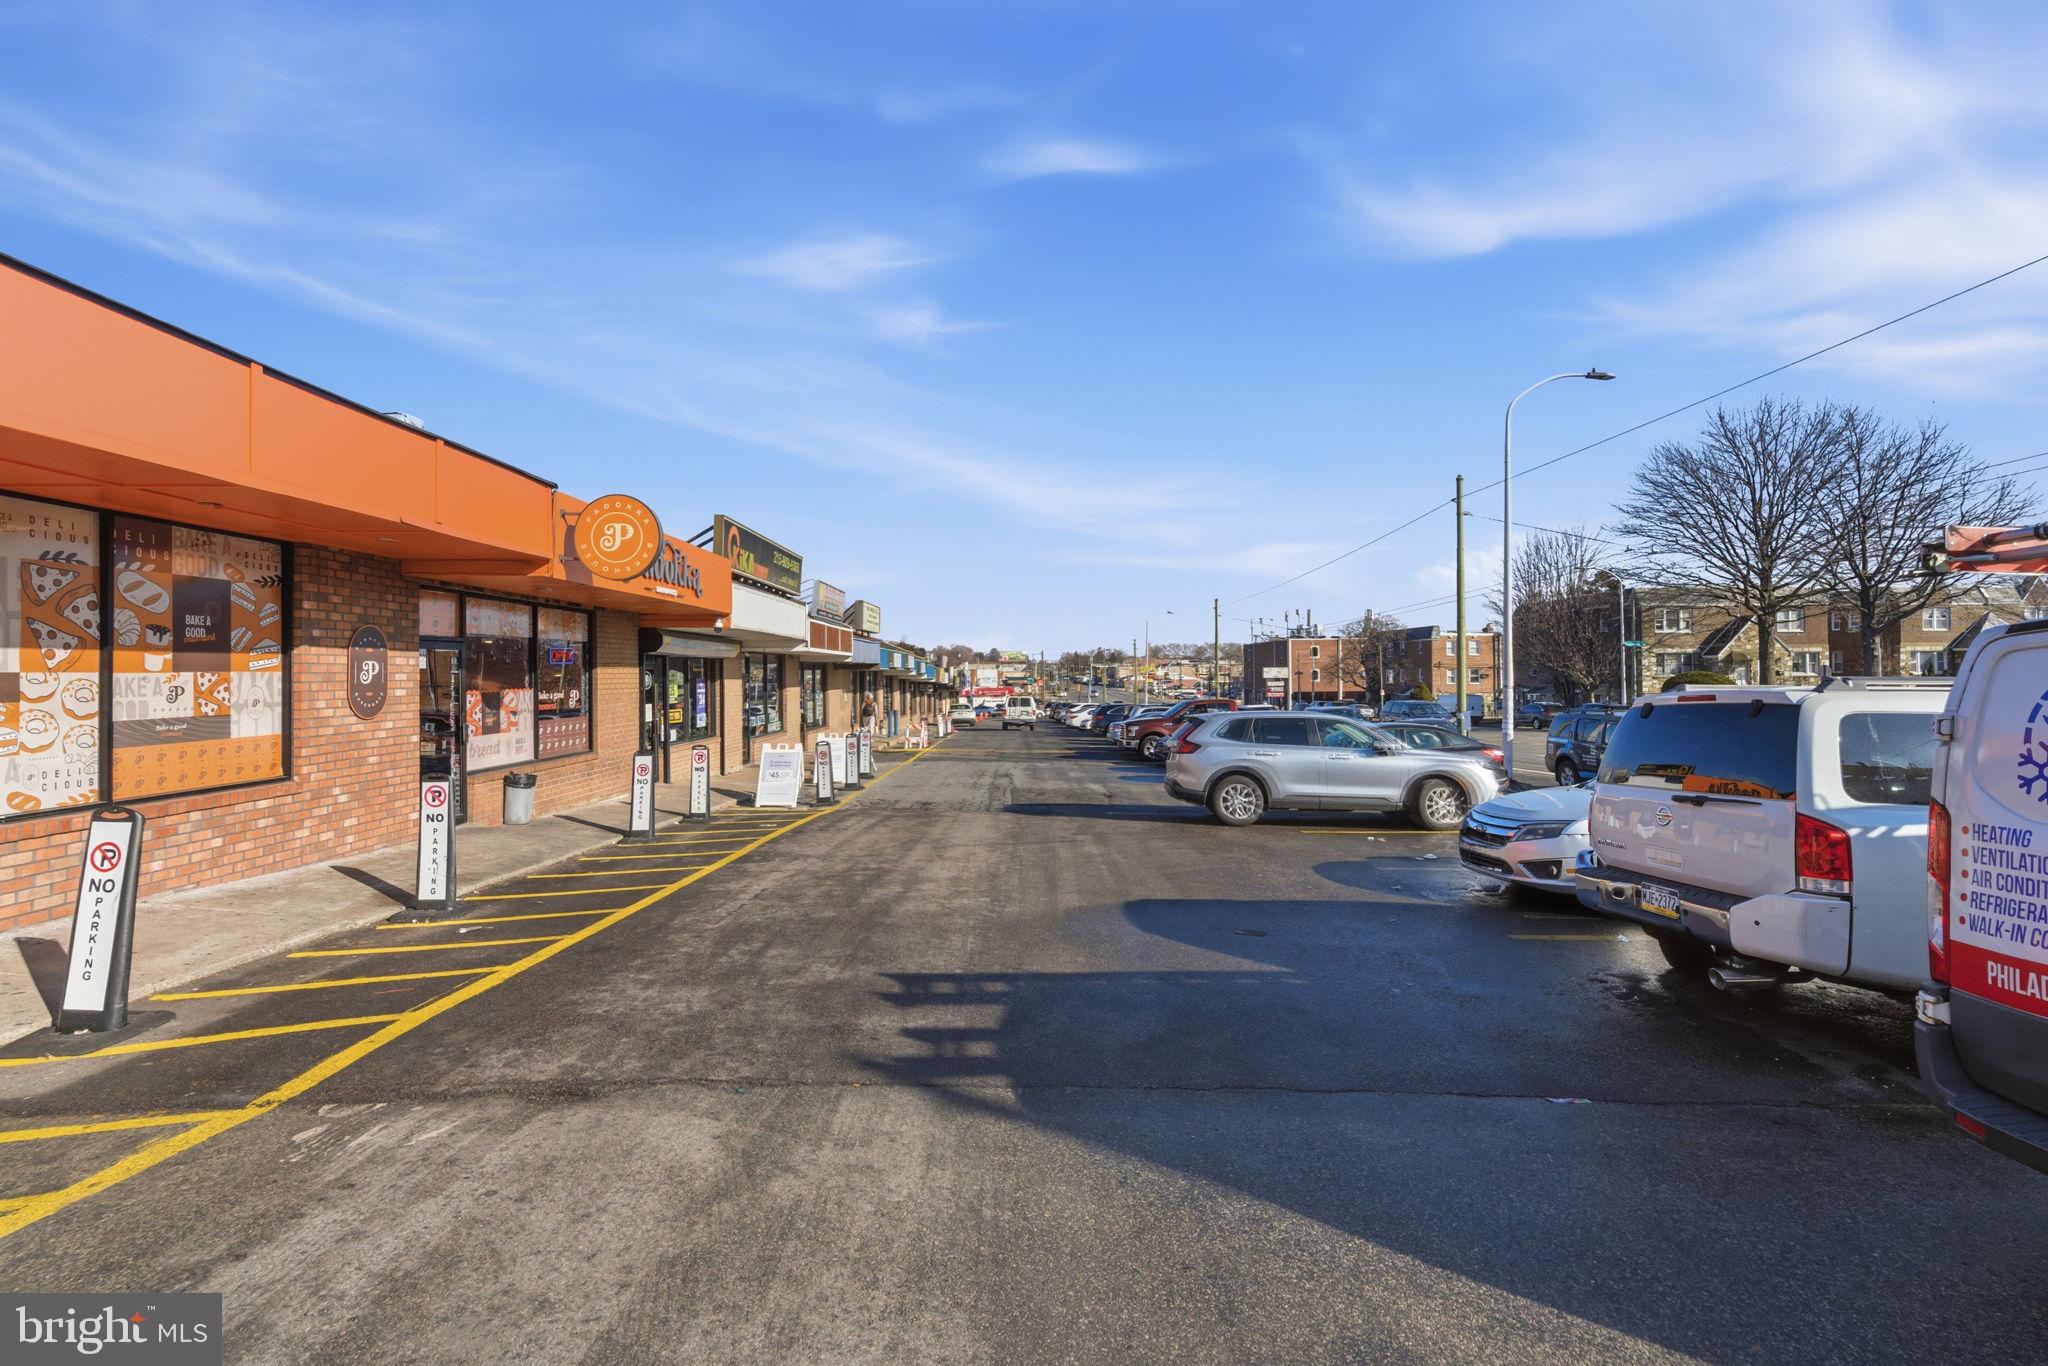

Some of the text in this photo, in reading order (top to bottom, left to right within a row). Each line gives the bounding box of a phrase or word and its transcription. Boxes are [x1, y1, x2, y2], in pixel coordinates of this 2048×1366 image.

[29, 515, 75, 530] DELI
[29, 529, 89, 545] CIOUS
[185, 614, 212, 626] BAKE A
[185, 627, 206, 638] GOOD
[41, 767, 82, 780] DELI
[41, 777, 95, 792] CIOUS
[426, 813, 444, 823] NO
[1972, 823, 2033, 848] HEATING
[430, 828, 438, 895] PARKING
[88, 878, 115, 893] NO
[1971, 868, 1992, 889] AIR
[1969, 913, 2027, 944] WALK-IN
[82, 897, 104, 981] PARKING
